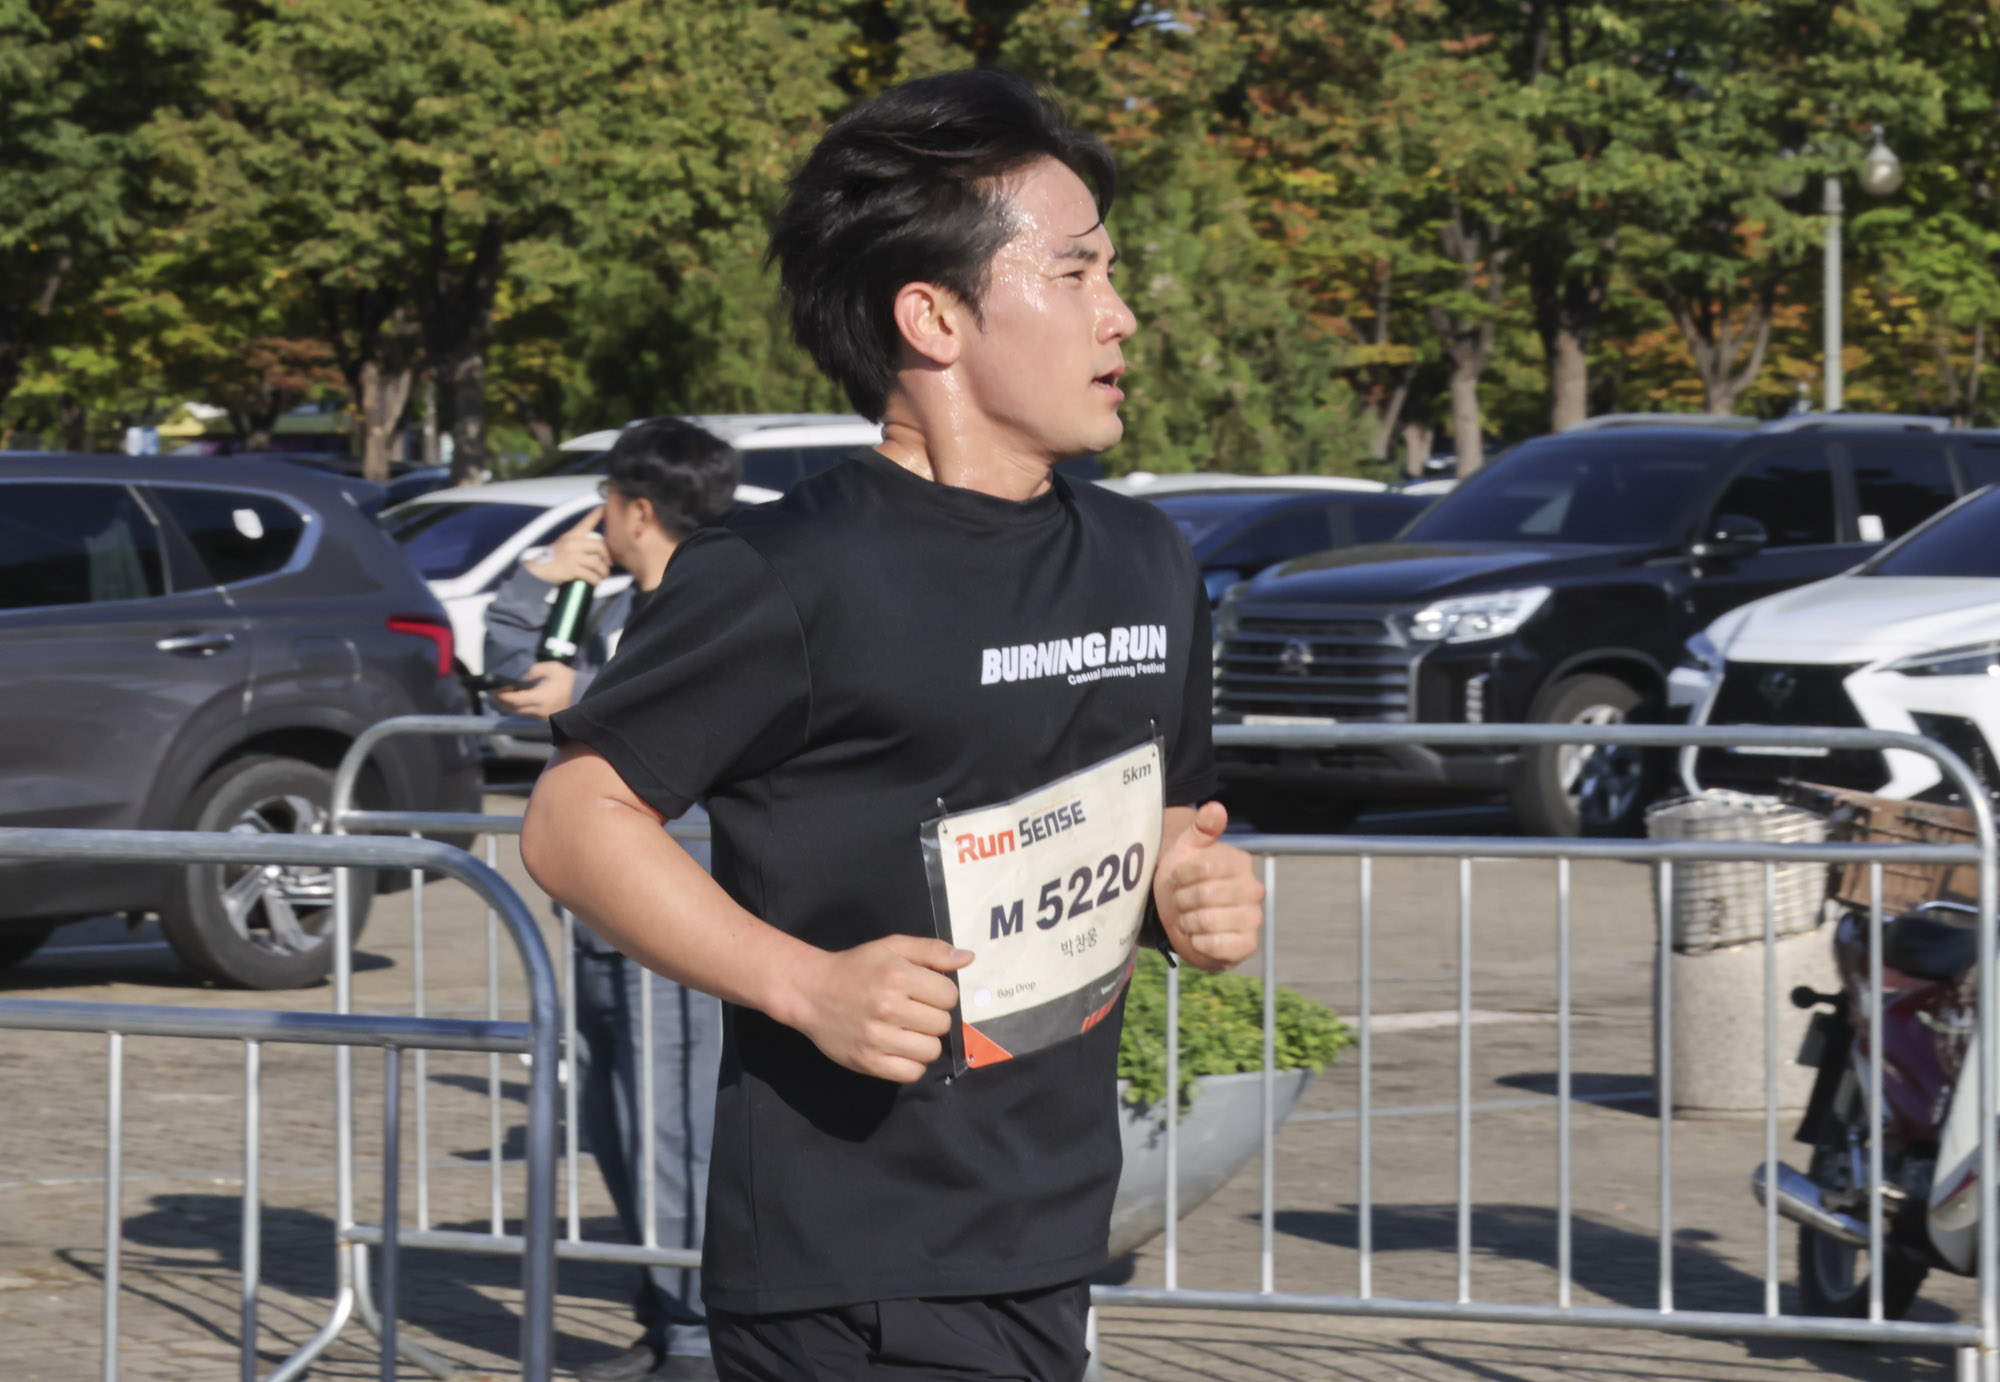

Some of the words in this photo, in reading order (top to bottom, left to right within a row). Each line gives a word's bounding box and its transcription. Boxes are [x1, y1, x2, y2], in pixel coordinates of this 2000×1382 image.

[981, 632, 1106, 685] BURNING
[1108, 625, 1167, 662] RUN
[1067, 668, 1100, 685] Casual
[1136, 662, 1166, 674] Festival
[1123, 763, 1151, 785] 5km
[955, 829, 1015, 864] Run
[990, 899, 1024, 940] M
[1036, 842, 1144, 930] 5220
[997, 987, 1014, 999] Bag
[1015, 981, 1036, 993] Drop
